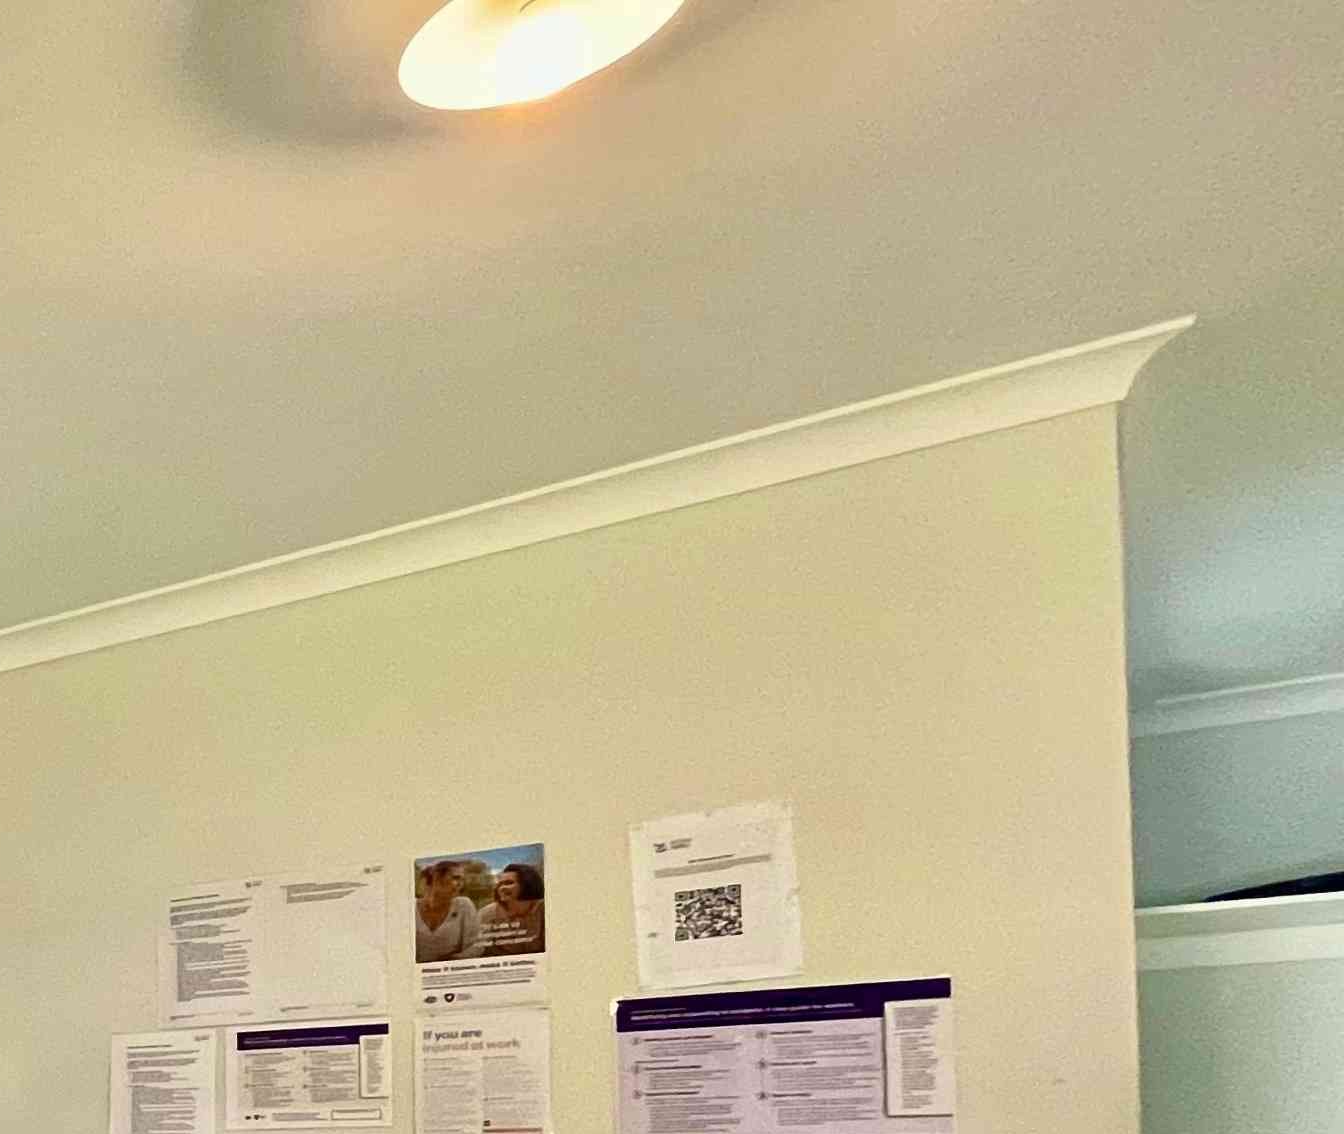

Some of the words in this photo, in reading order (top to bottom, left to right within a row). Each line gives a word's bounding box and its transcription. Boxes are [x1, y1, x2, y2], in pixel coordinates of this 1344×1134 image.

[435, 1031, 459, 1041] you
[461, 1029, 483, 1039] are
[471, 1041, 484, 1050] at
[486, 1038, 521, 1049] work
